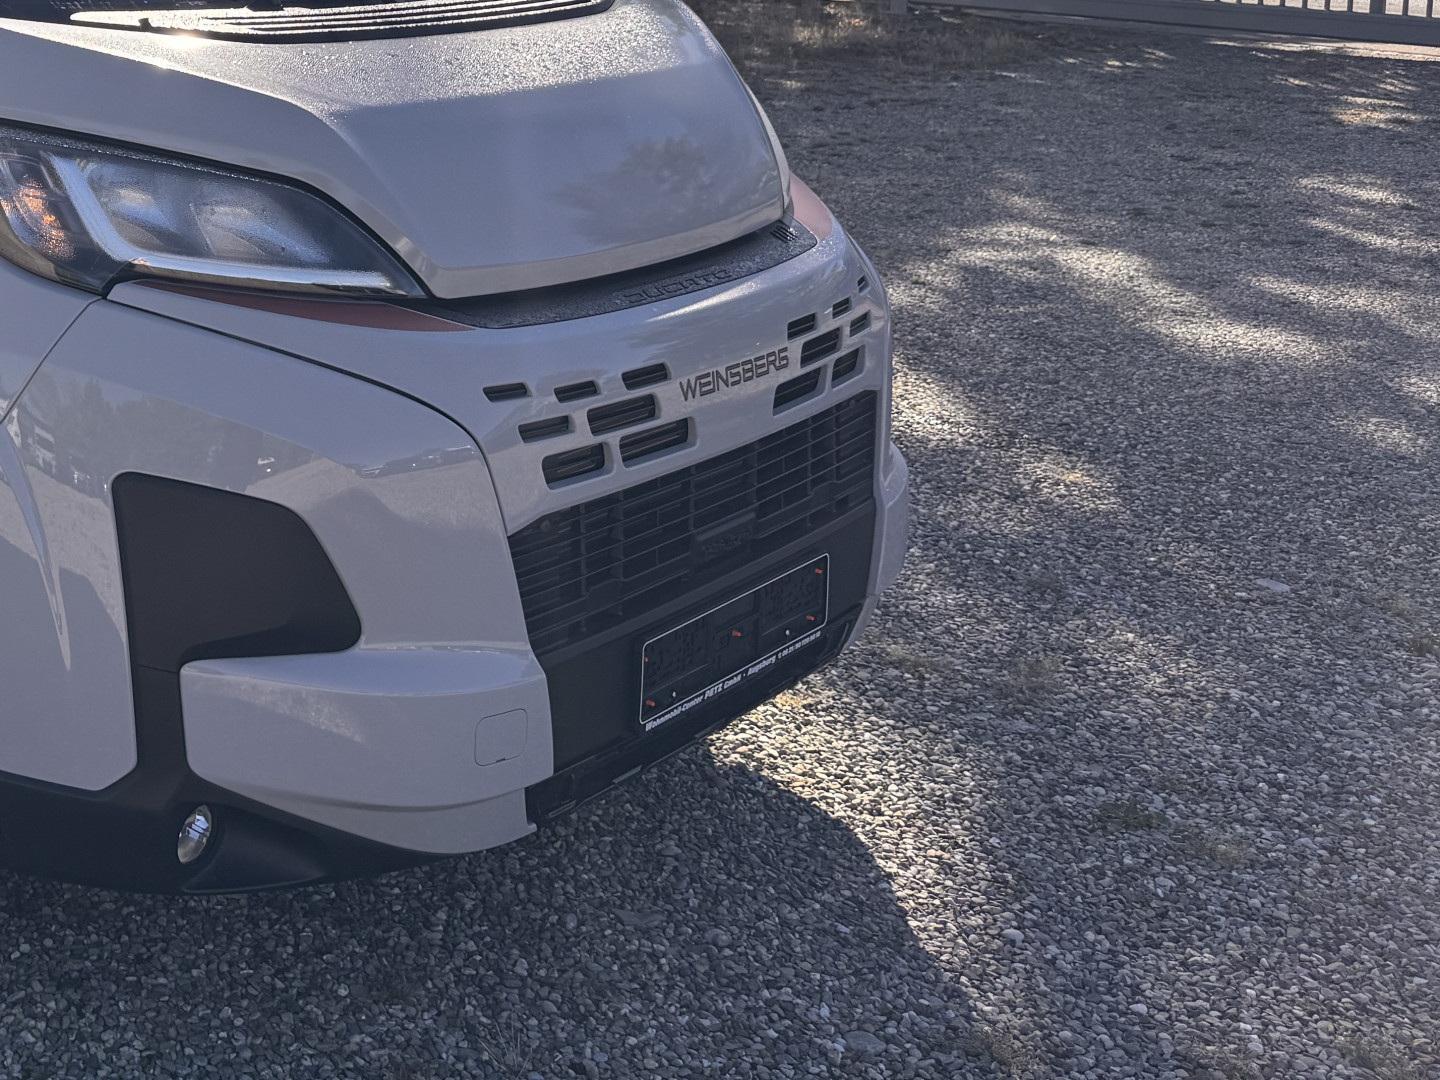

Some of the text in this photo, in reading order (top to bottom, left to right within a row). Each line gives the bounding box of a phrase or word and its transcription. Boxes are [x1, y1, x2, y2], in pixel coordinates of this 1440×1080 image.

[679, 346, 789, 402] WEINSBERG
[645, 695, 704, 732] Wohnmobil-Center
[704, 682, 724, 700] PETZ
[723, 674, 742, 689] GmbH
[747, 655, 777, 676] Augsburg
